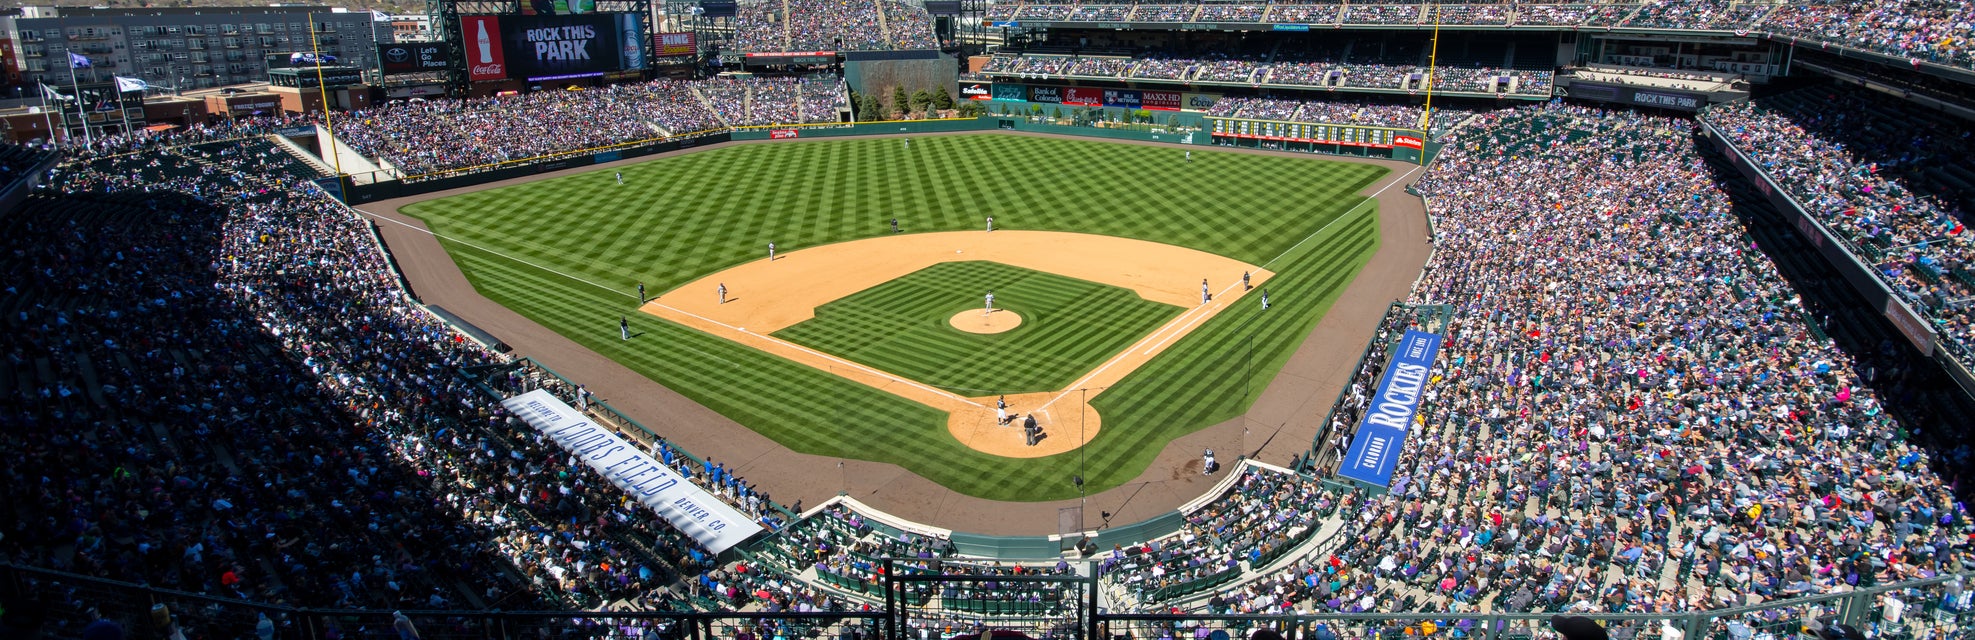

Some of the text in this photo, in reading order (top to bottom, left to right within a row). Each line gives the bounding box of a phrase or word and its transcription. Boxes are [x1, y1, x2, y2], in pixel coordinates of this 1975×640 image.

[526, 25, 596, 42] ROCK THIS
[662, 34, 689, 45] KING
[535, 40, 591, 60] PARK
[1034, 94, 1062, 102] Colorado
[1168, 94, 1180, 102] HD
[1634, 92, 1697, 108] ROCK THIS PARK
[1368, 362, 1428, 431] ROCKIES
[527, 400, 554, 417] WELCOME
[554, 422, 677, 497] COORS FIELD
[1363, 437, 1386, 468] COLORADO
[674, 497, 727, 534] DENVER, CO.
